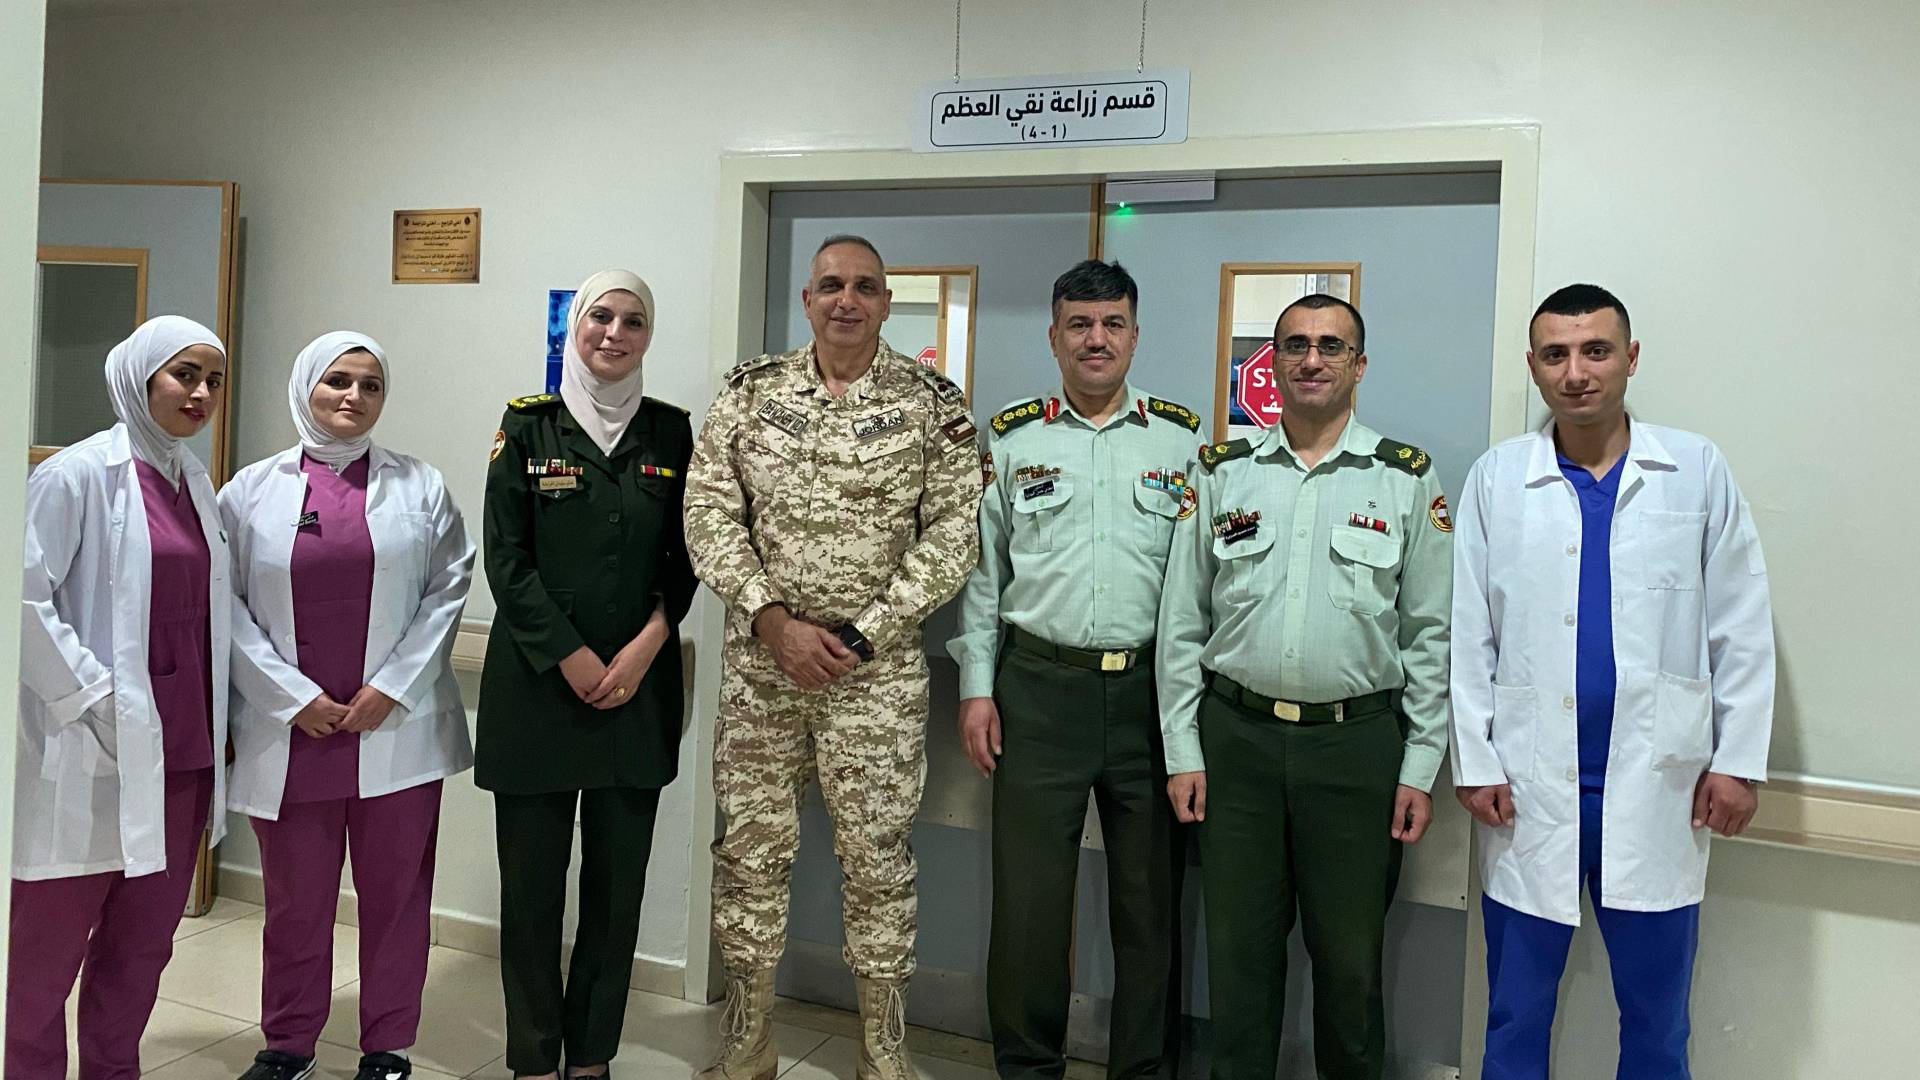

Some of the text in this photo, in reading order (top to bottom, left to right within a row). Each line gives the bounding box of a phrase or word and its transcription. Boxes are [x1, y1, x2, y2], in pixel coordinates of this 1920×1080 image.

[941, 86, 1155, 128] قسم زراعة نقي العظم
[1252, 367, 1277, 388] ST
[859, 415, 903, 437] JORDAN
